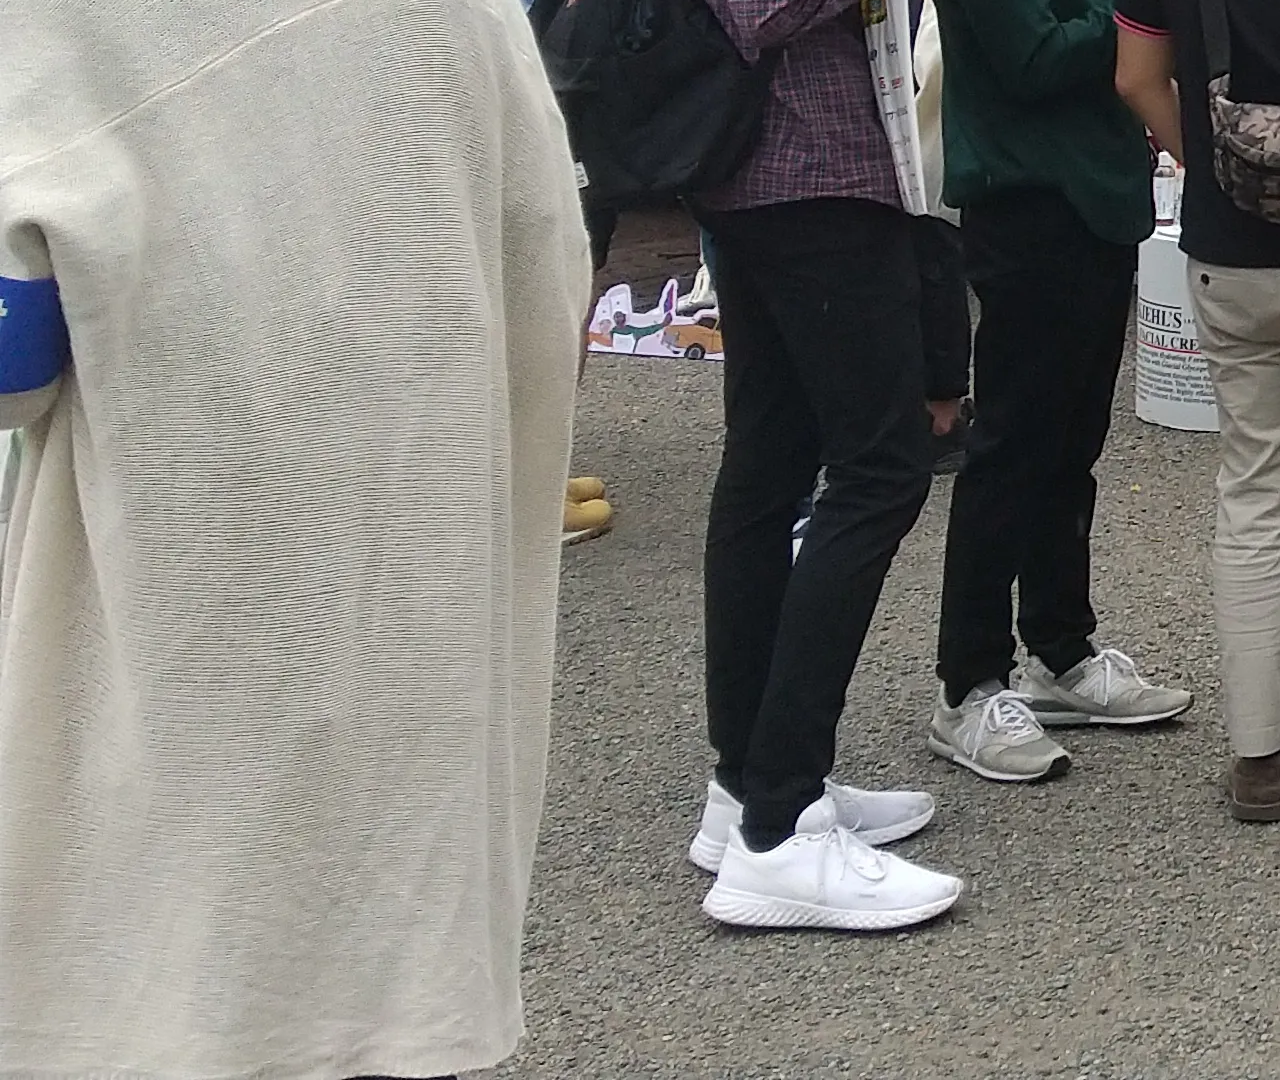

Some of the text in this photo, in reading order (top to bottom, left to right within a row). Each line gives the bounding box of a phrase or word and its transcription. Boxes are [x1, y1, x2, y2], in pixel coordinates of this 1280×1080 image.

[1139, 304, 1182, 329] IEHL'S
[1139, 327, 1199, 351] ACIAL CRE
